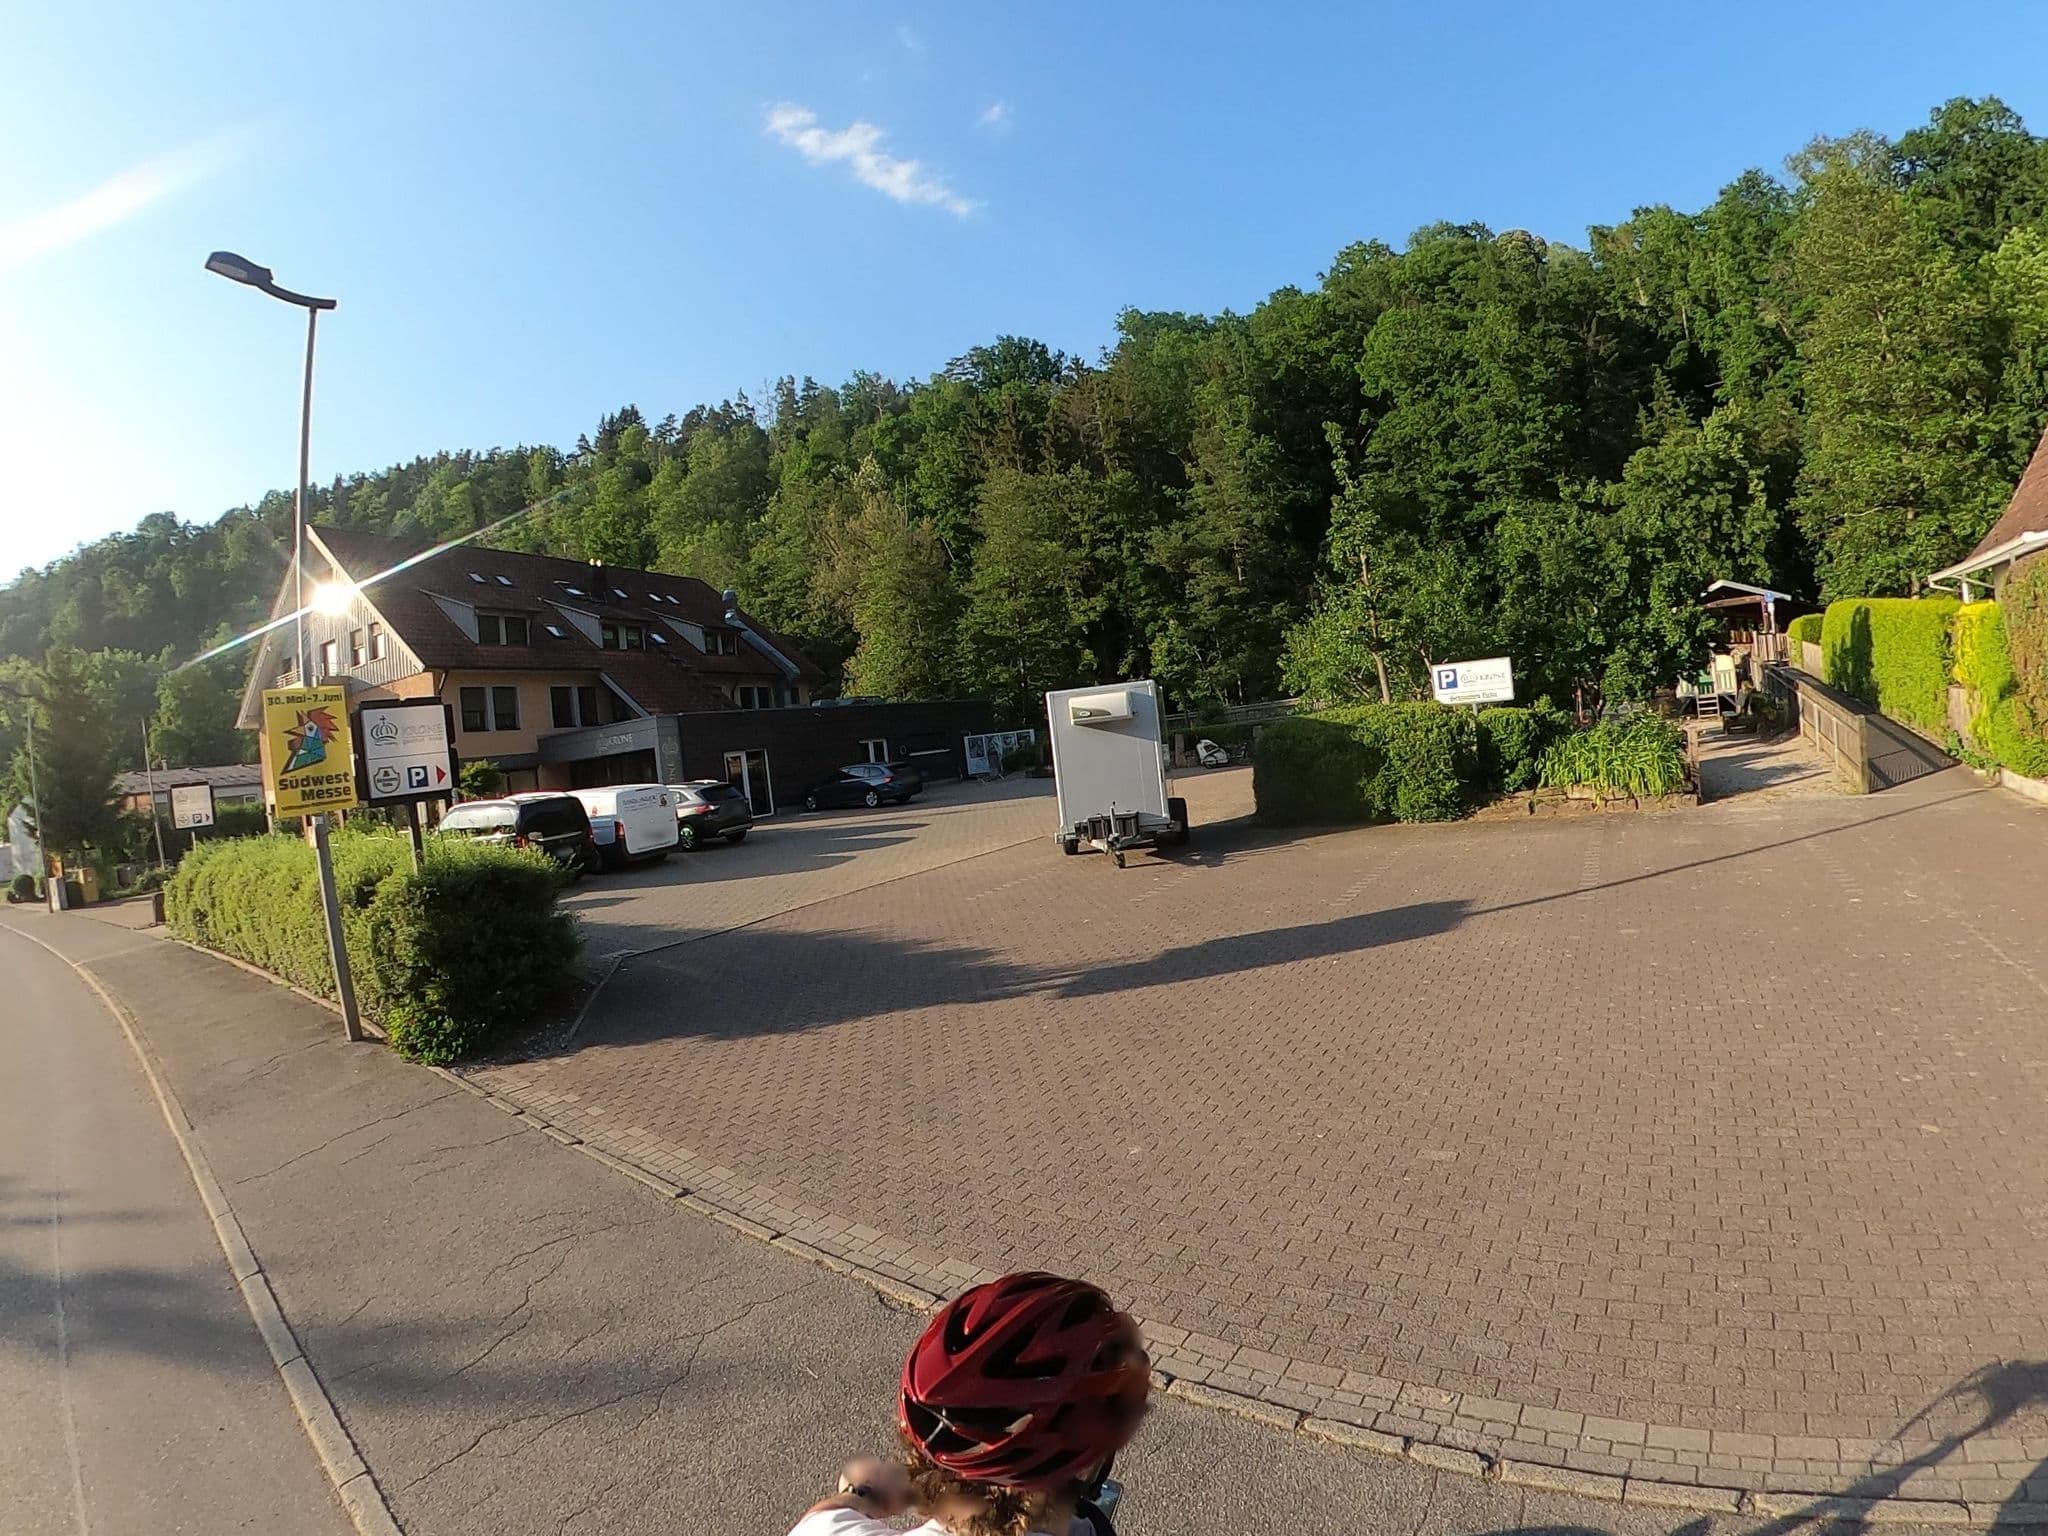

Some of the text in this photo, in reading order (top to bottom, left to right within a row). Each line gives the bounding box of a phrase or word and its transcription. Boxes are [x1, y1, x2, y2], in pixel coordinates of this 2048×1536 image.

[1440, 671, 1455, 689] P
[267, 696, 284, 706] 30.
[278, 771, 351, 791] Südwest
[410, 768, 425, 787] P
[301, 785, 352, 802] Messe
